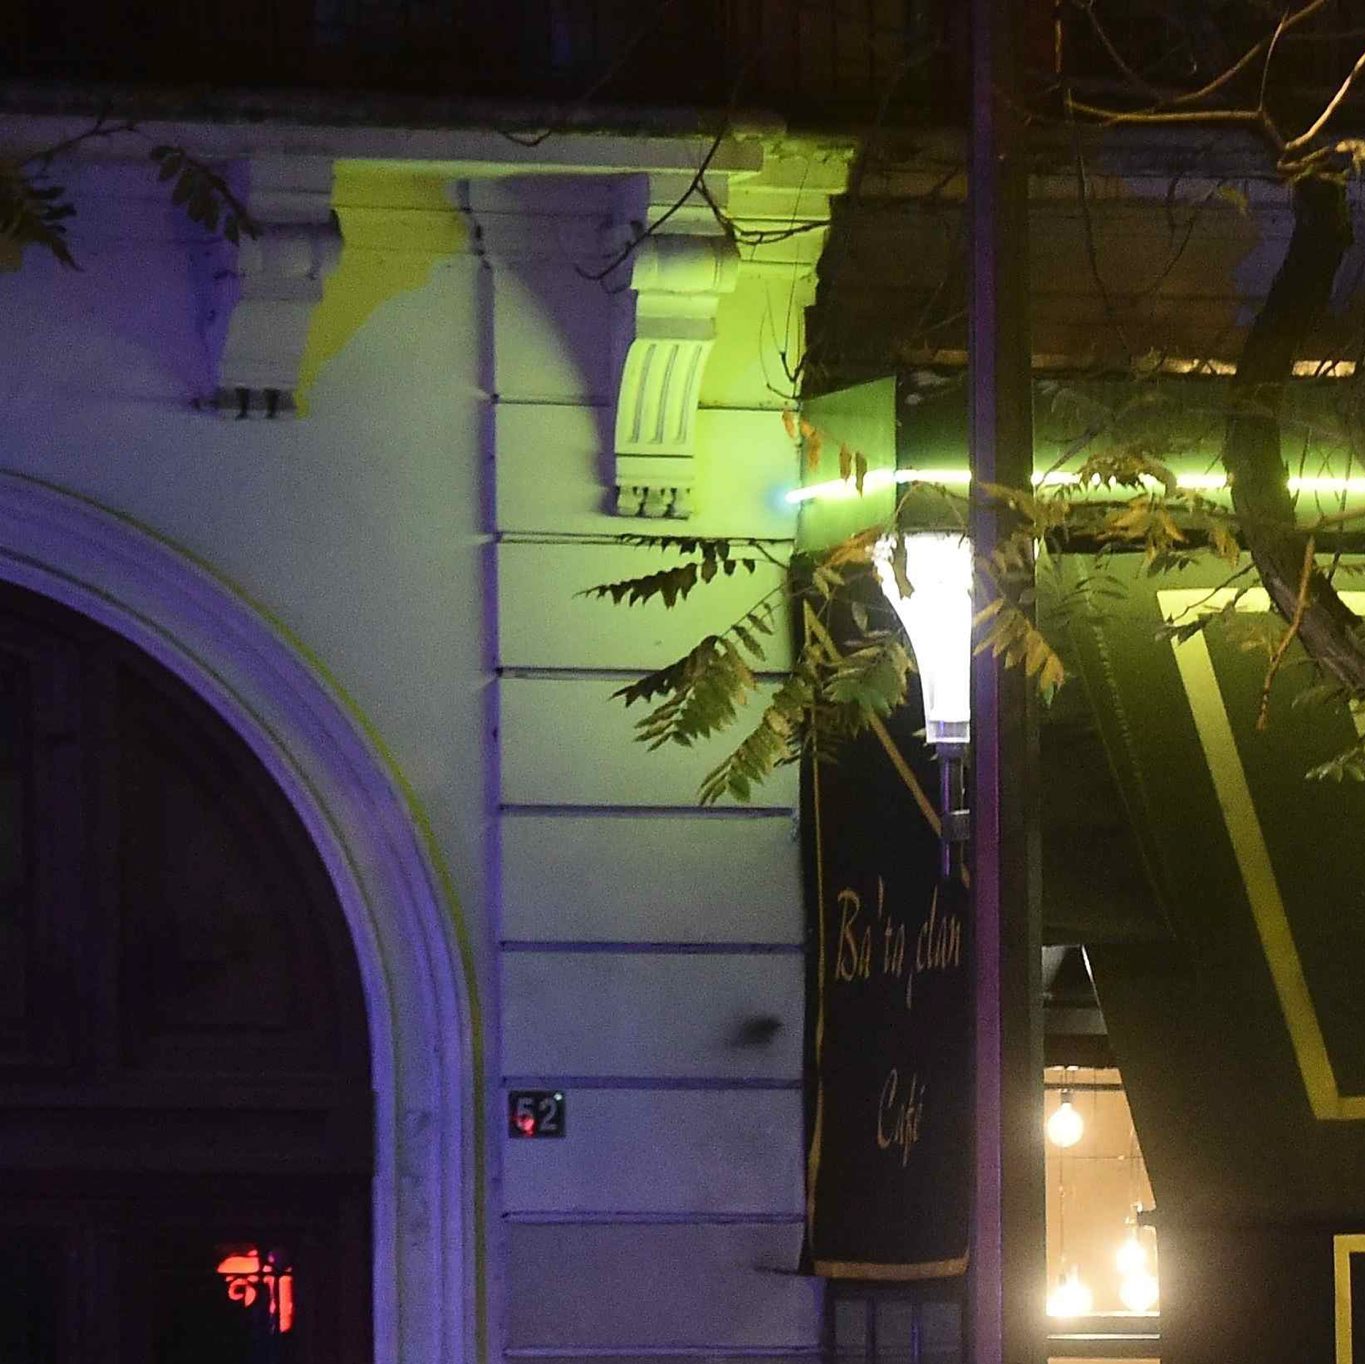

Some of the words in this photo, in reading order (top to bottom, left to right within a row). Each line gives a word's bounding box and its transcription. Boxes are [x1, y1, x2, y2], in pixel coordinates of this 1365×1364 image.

[916, 884, 961, 973] clan
[517, 1097, 558, 1131] 52
[877, 1066, 926, 1168] Café
